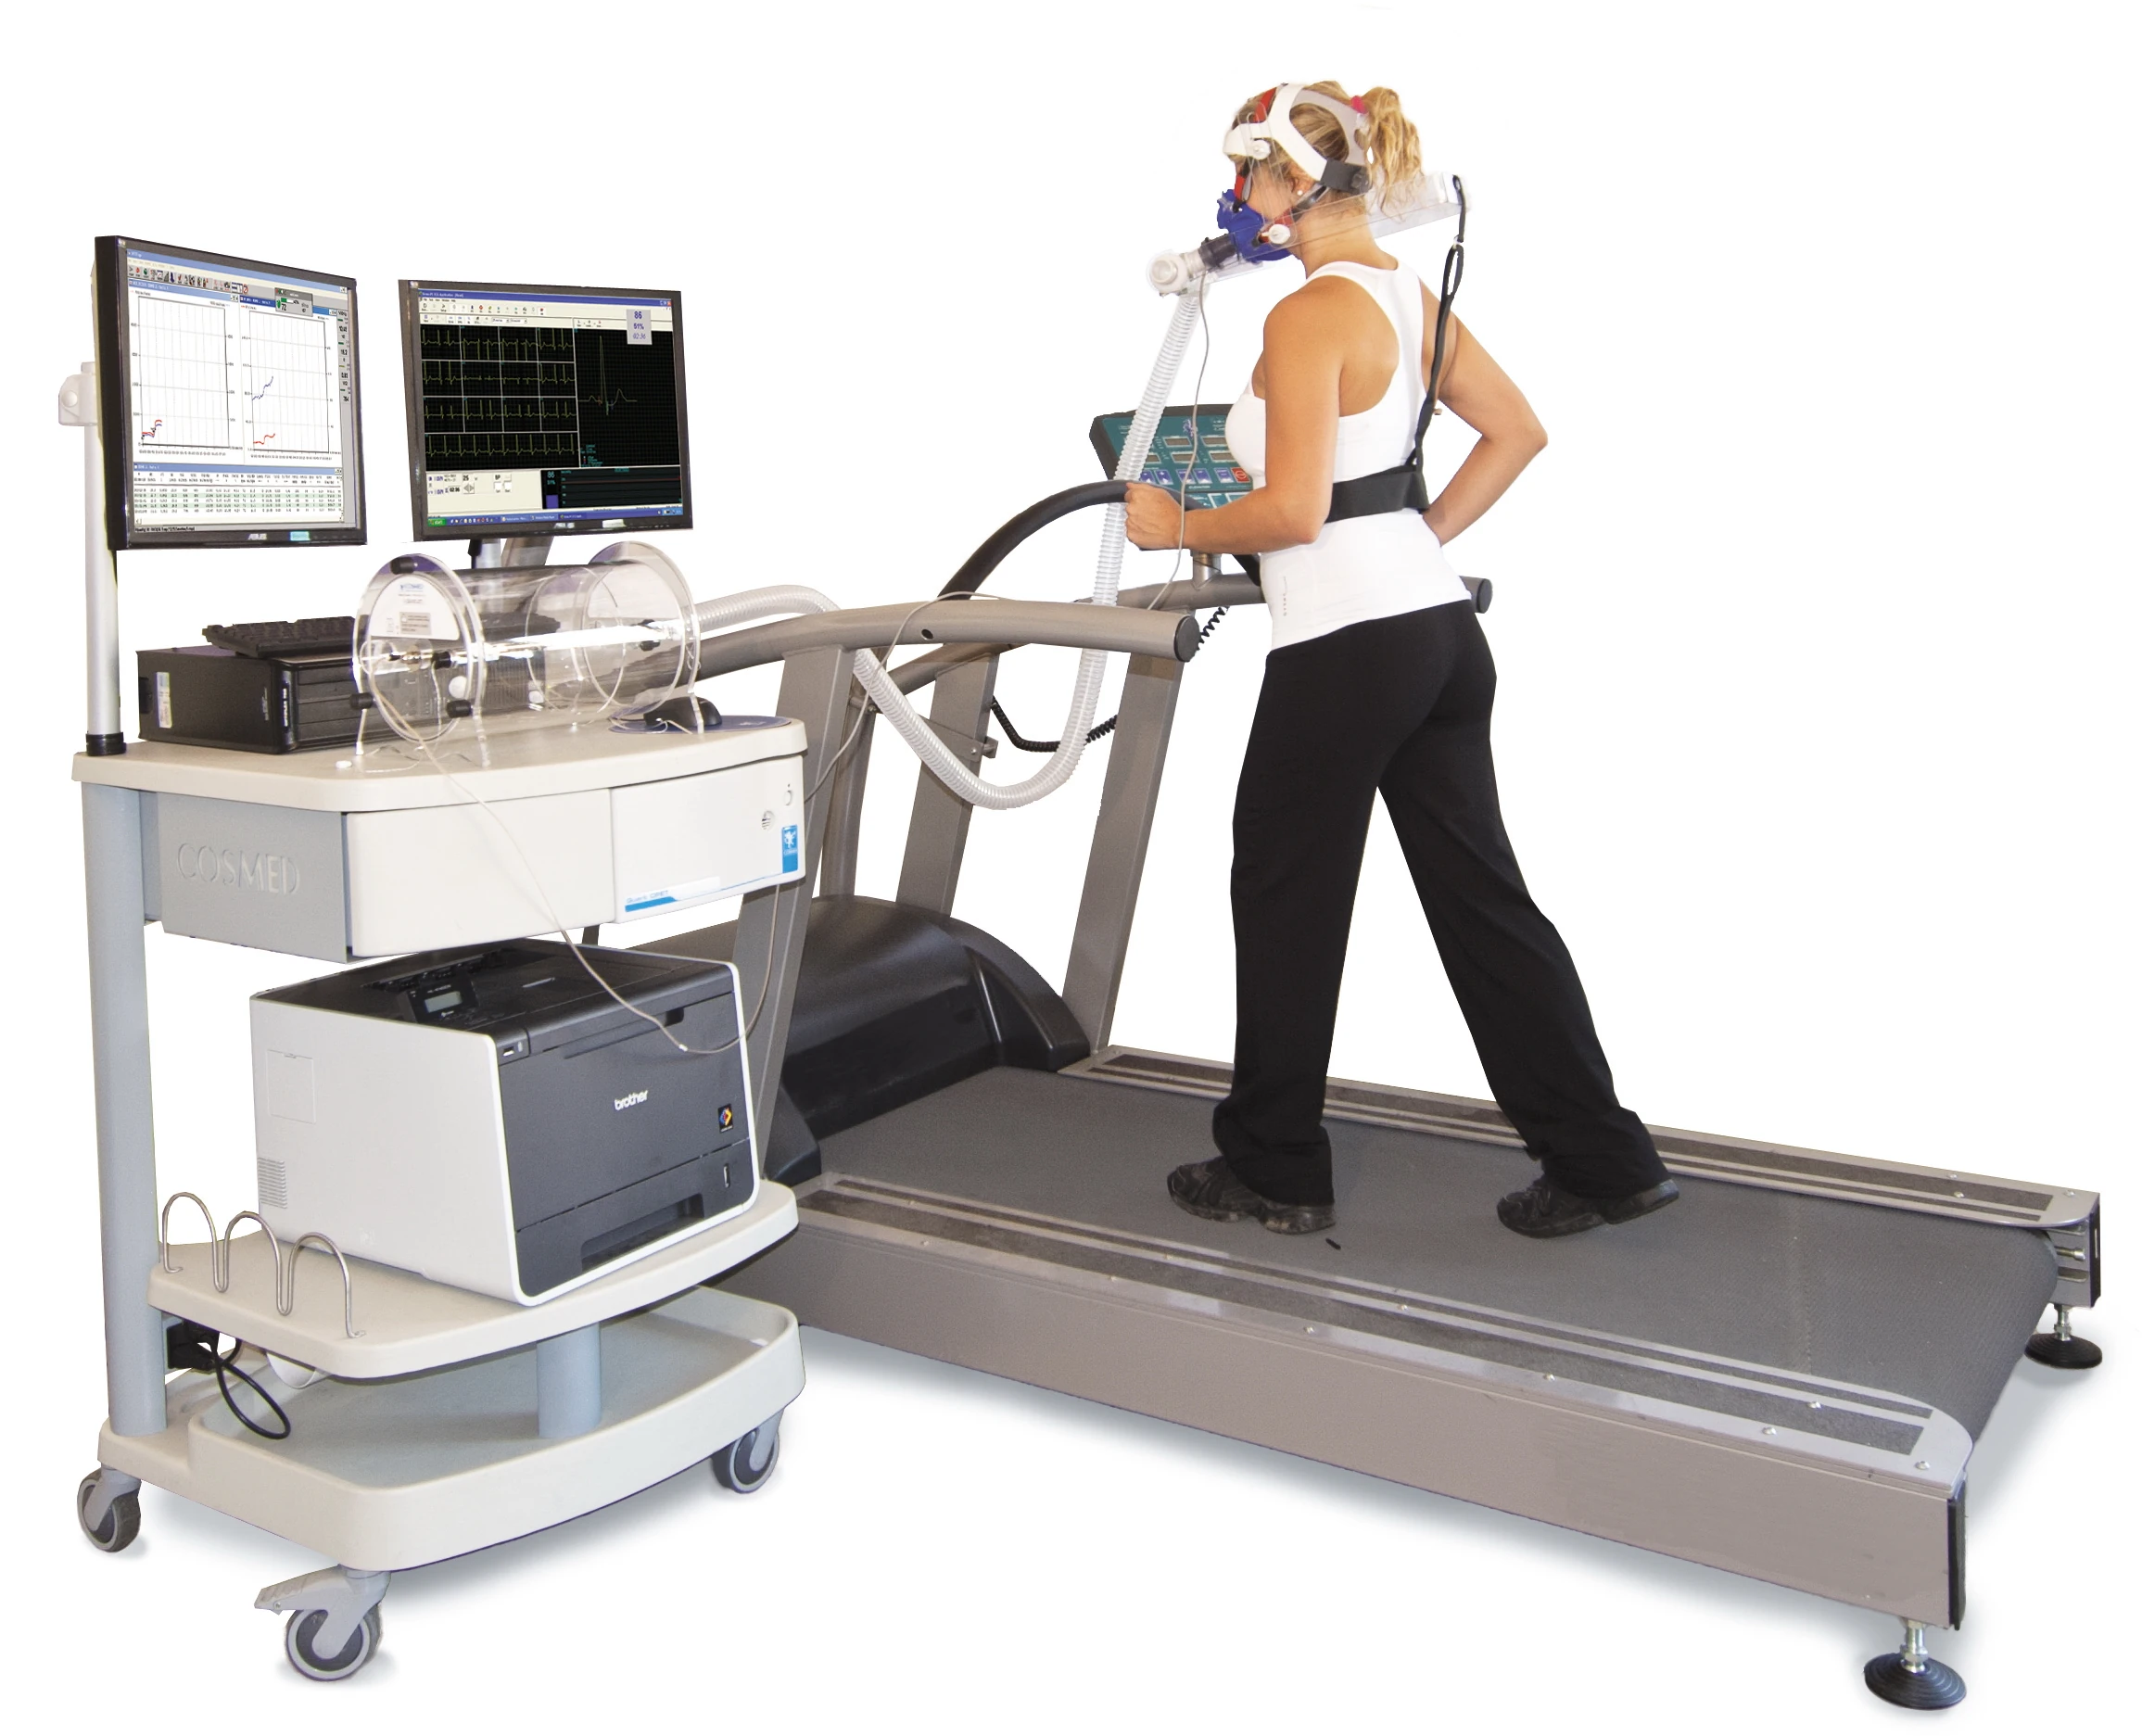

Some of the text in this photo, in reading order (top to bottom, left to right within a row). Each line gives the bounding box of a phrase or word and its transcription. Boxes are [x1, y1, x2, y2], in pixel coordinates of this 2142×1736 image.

[634, 310, 642, 319] 86
[176, 842, 301, 896] COSMED
[614, 1090, 648, 1110] brother
